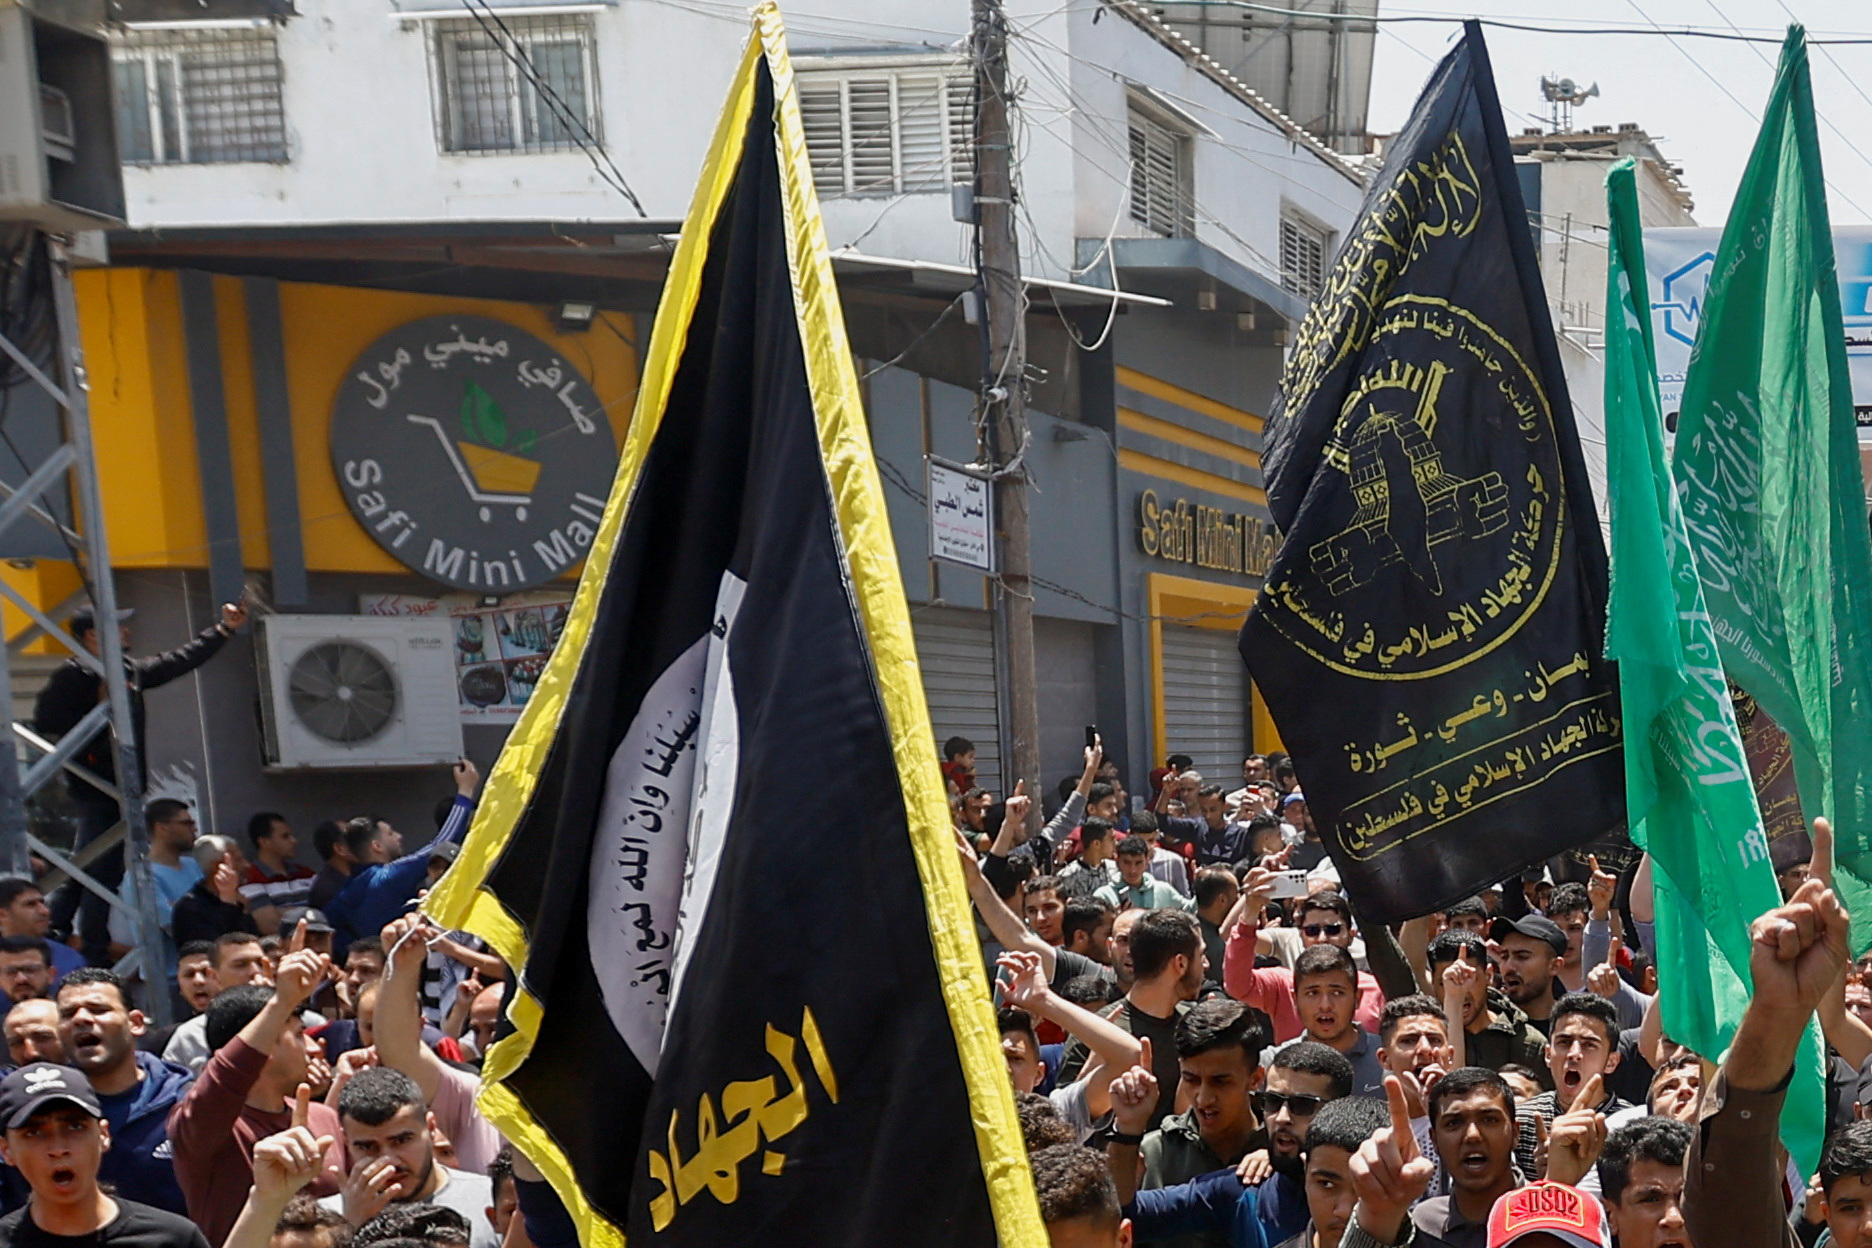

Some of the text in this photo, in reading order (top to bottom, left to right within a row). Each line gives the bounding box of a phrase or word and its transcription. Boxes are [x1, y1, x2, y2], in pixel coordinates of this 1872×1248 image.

[1423, 309, 1456, 341] فينا
[356, 323, 596, 435] صافي ميني مول
[344, 458, 608, 587] Safi Mini Mall
[1141, 488, 1285, 578] Safi Mini Mal
[1512, 462, 1550, 551] حركة
[1481, 548, 1533, 619] الجهاد
[1343, 622, 1376, 664] في
[1377, 601, 1484, 669] الإسلامي
[1343, 711, 1420, 773] ثورة
[1437, 689, 1509, 743] وعي
[1540, 712, 1595, 762] الجهاد
[1427, 779, 1450, 820] في
[1453, 744, 1536, 808] الإسلامي
[1345, 791, 1424, 851] فلسطين
[649, 1005, 839, 1233] الجهاد
[1528, 1187, 1579, 1214] DSQ2
